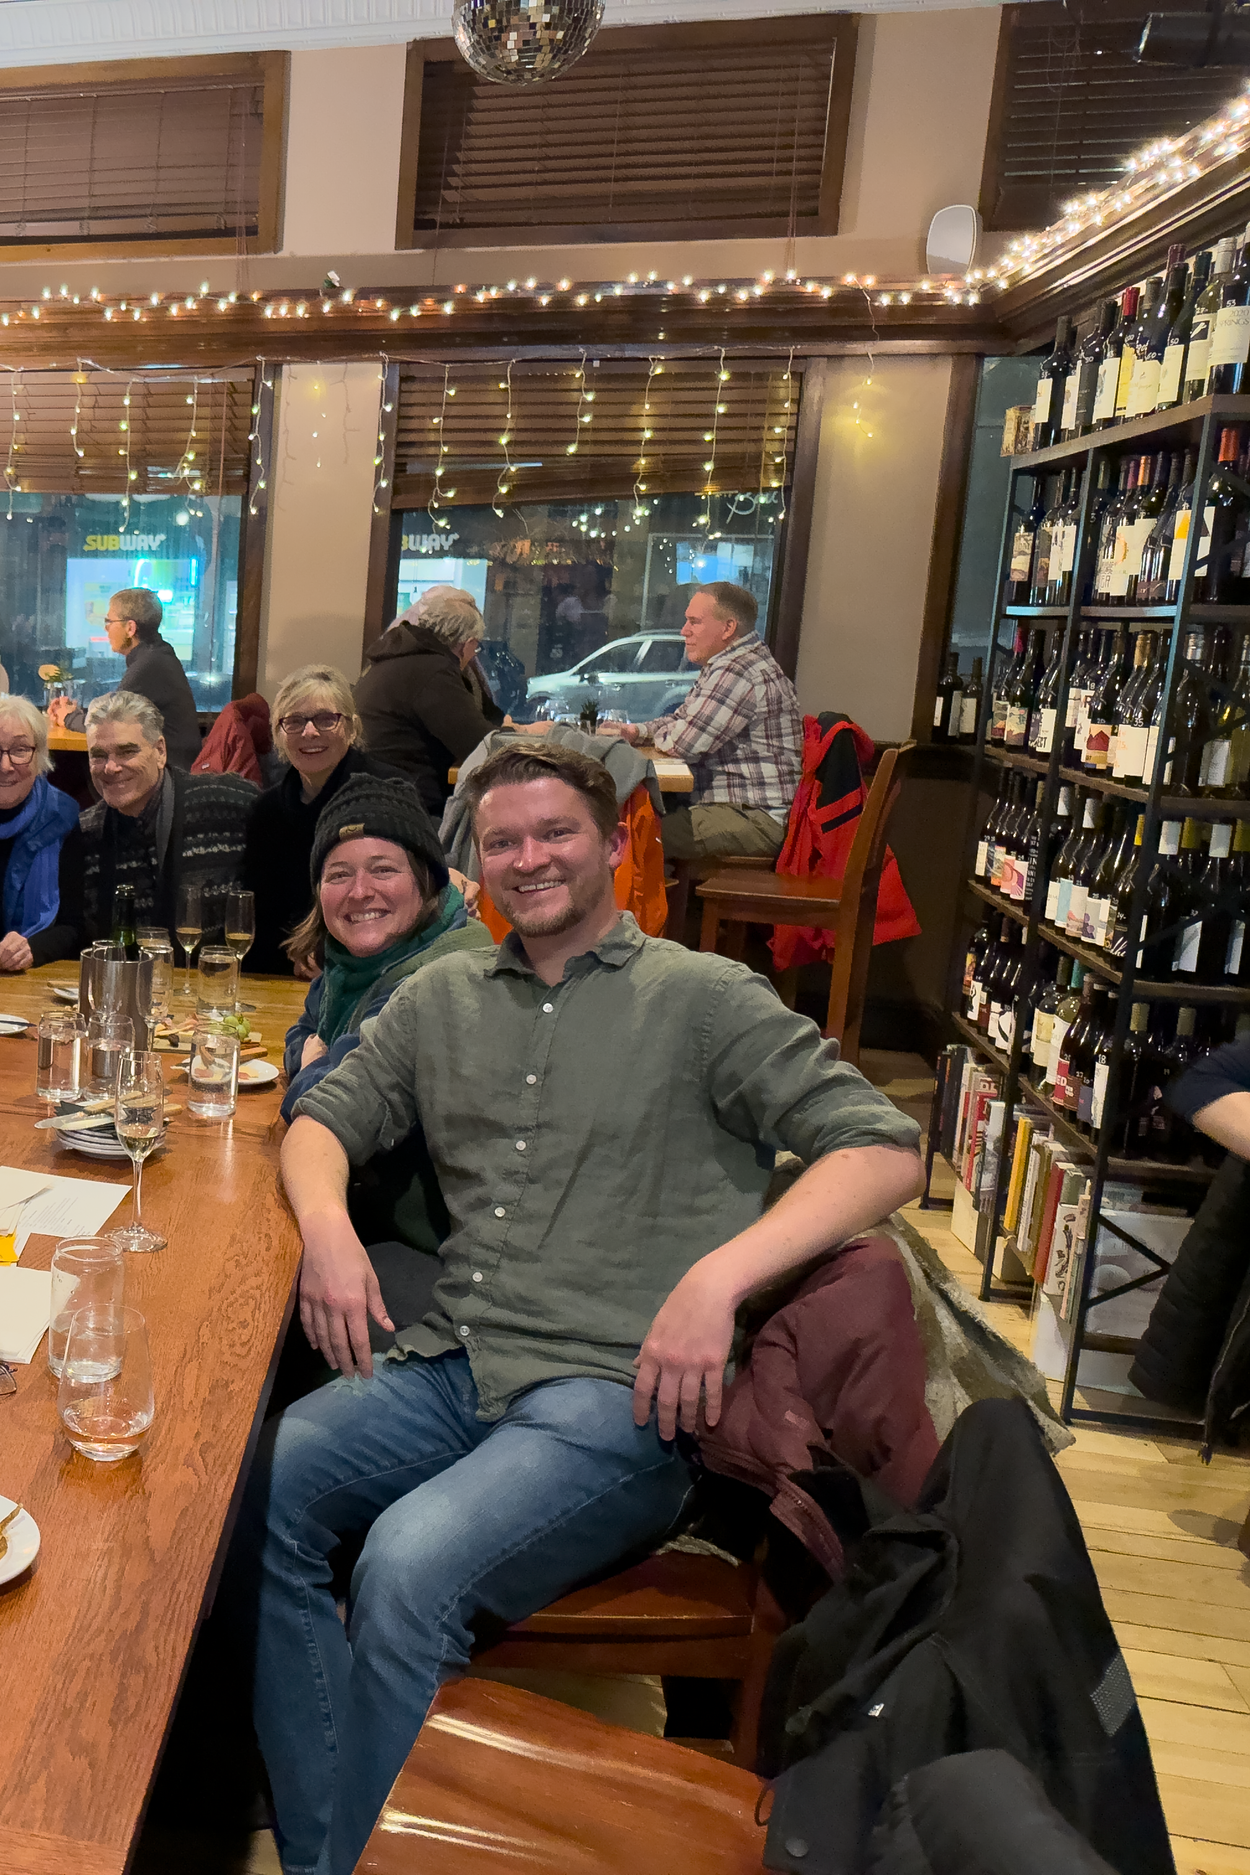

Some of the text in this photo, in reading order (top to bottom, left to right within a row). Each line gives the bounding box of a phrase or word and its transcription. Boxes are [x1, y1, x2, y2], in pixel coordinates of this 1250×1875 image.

[1230, 308, 1250, 317] 2020
[83, 533, 167, 551] SUBWAY
[1133, 717, 1144, 727] 35
